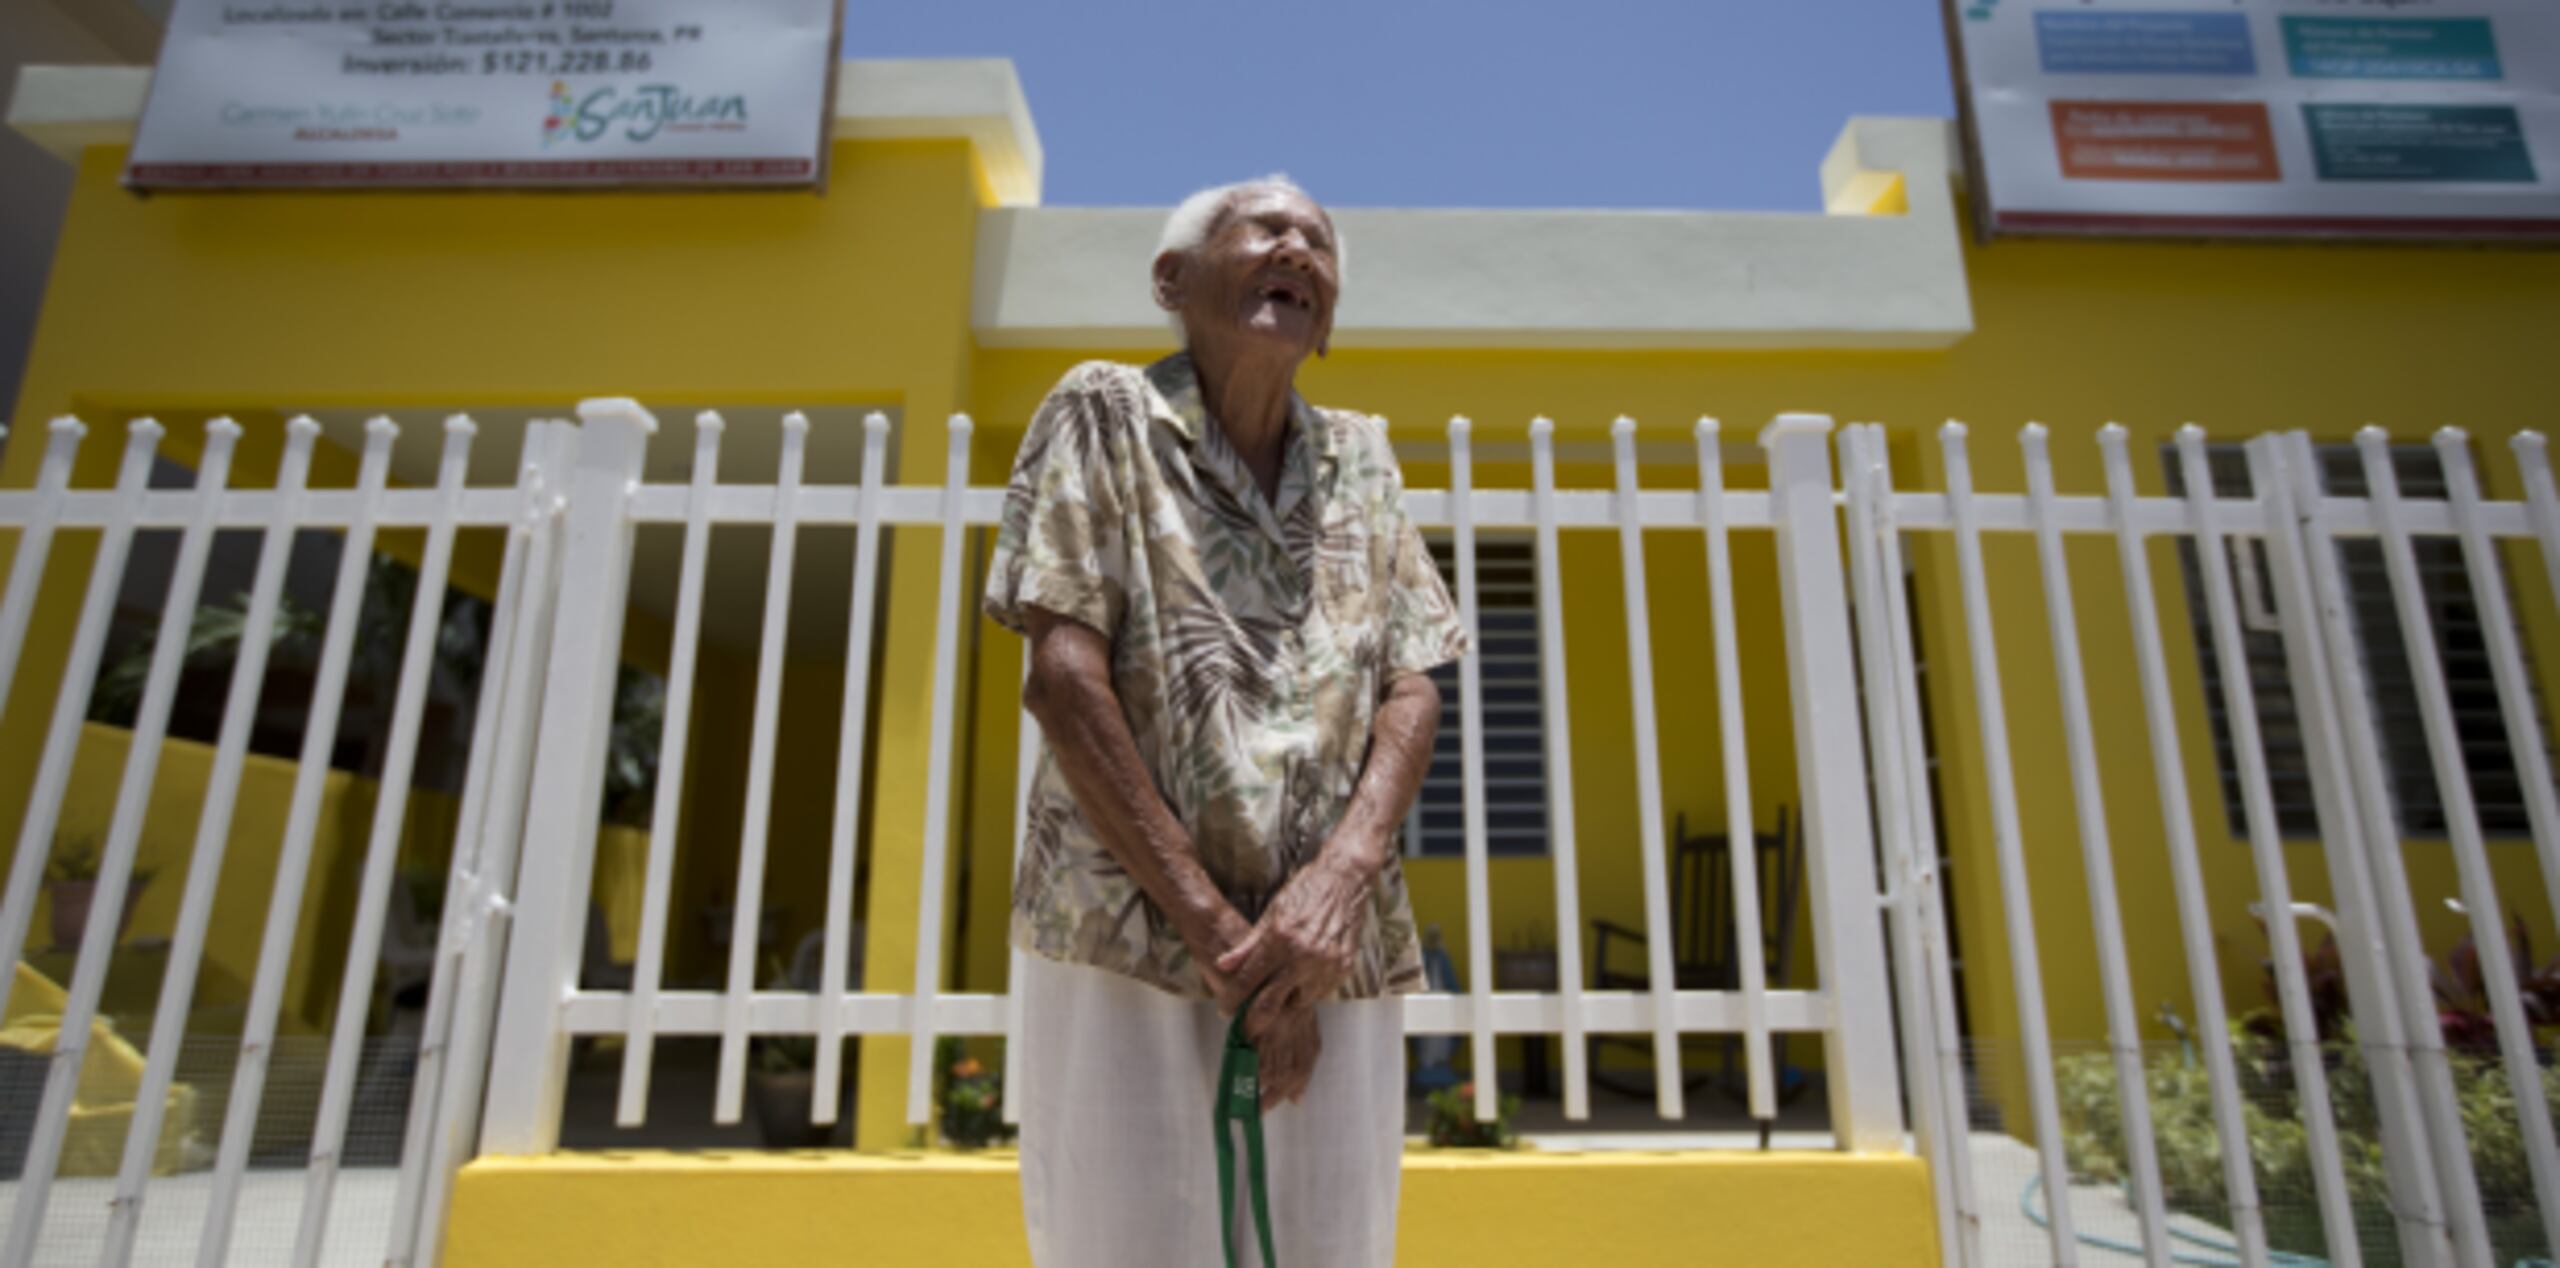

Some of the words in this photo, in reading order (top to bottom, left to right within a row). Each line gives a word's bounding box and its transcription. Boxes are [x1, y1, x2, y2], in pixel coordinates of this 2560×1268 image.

[376, 2, 428, 20] Calle
[562, 0, 614, 19] 1002
[341, 51, 473, 75] Inversión:
[482, 50, 653, 76] $121,228.86
